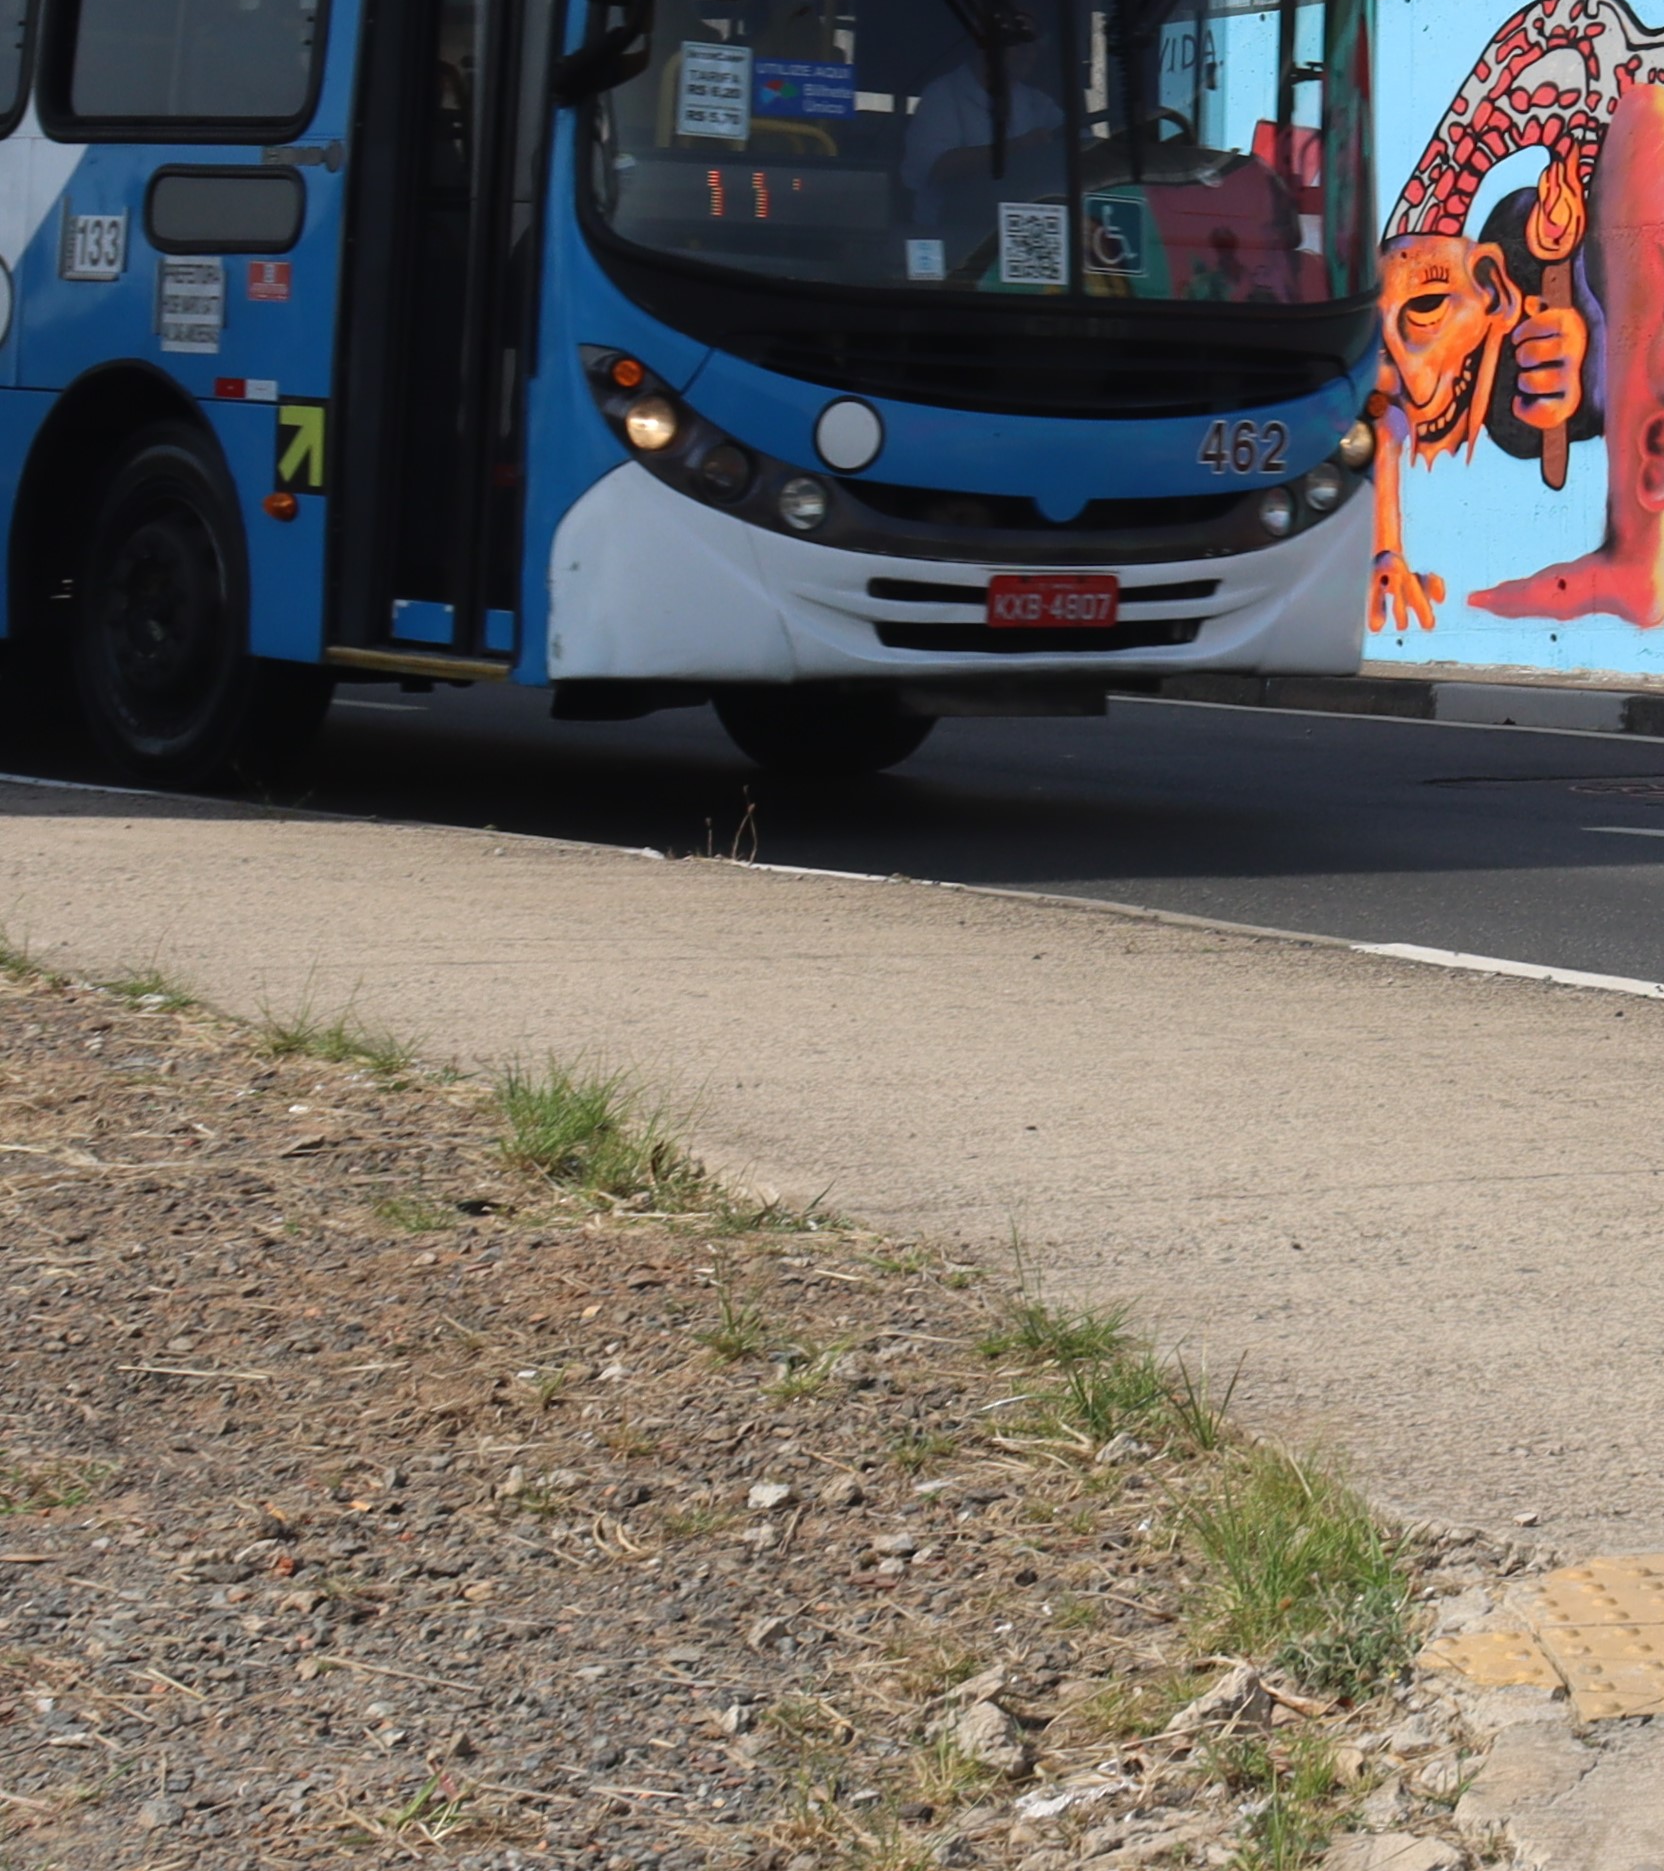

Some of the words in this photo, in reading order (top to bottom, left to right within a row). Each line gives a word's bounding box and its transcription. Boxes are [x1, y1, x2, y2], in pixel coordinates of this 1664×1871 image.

[755, 62, 812, 77] UTILIZE
[815, 66, 850, 79] AQUI
[77, 219, 119, 267] 133
[1197, 419, 1290, 475] 462
